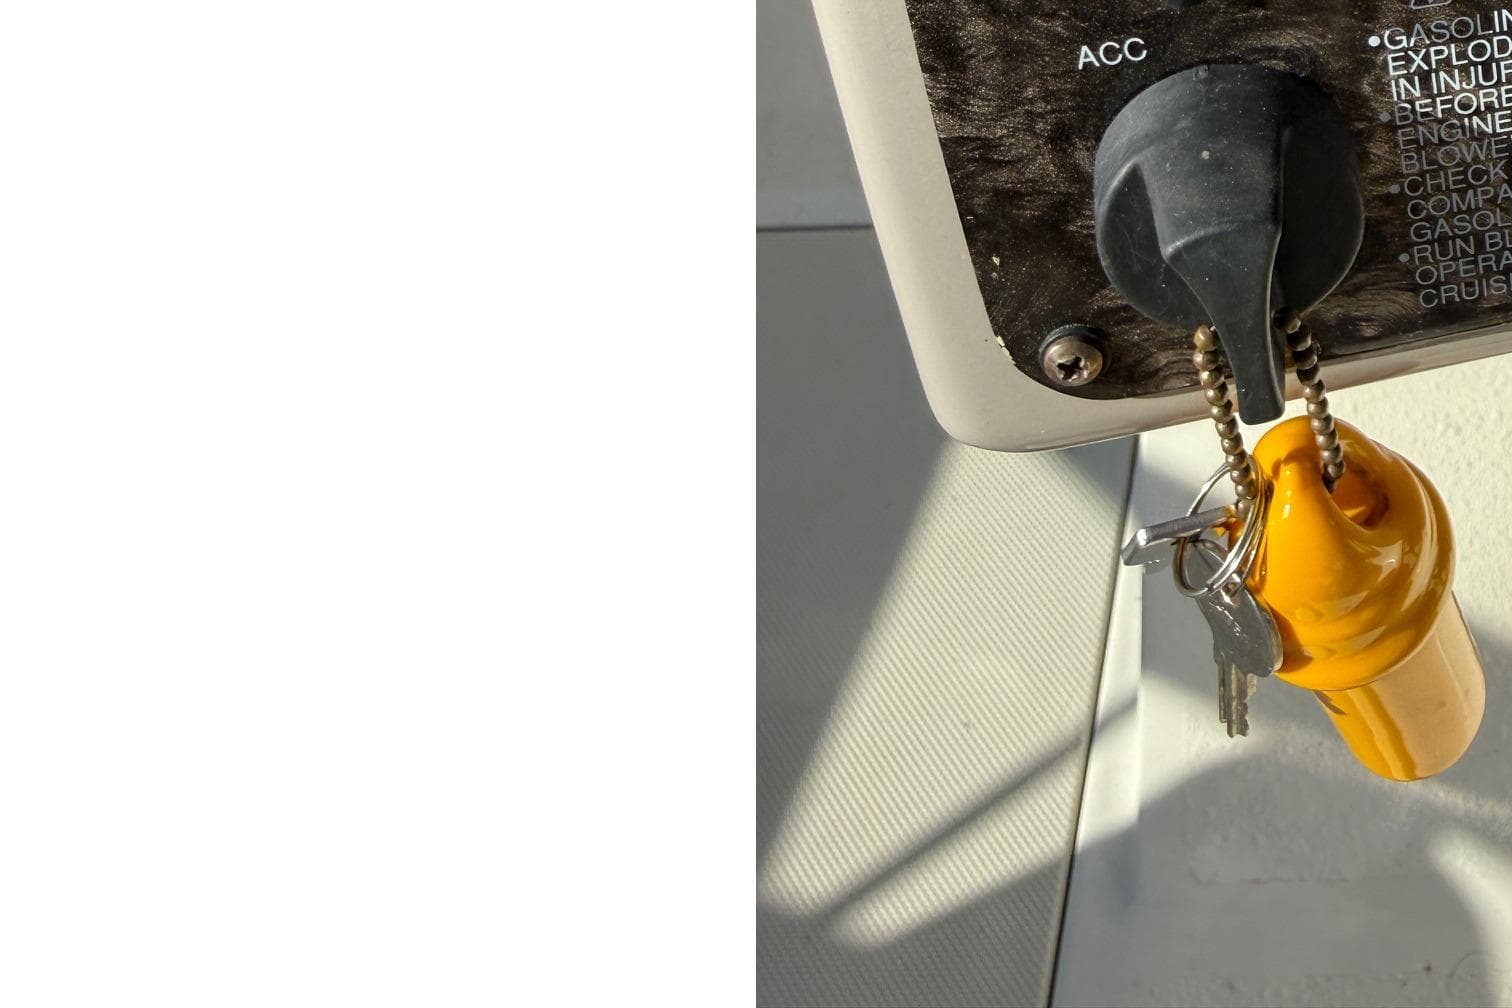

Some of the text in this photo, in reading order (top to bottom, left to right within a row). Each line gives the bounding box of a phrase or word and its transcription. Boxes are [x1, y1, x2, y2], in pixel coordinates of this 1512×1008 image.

[1078, 37, 1148, 71] ACC
[1391, 78, 1421, 101] IN
[1397, 112, 1512, 149] ENGINE
[1405, 161, 1508, 196] CHECK
[1413, 239, 1474, 265] RUN
